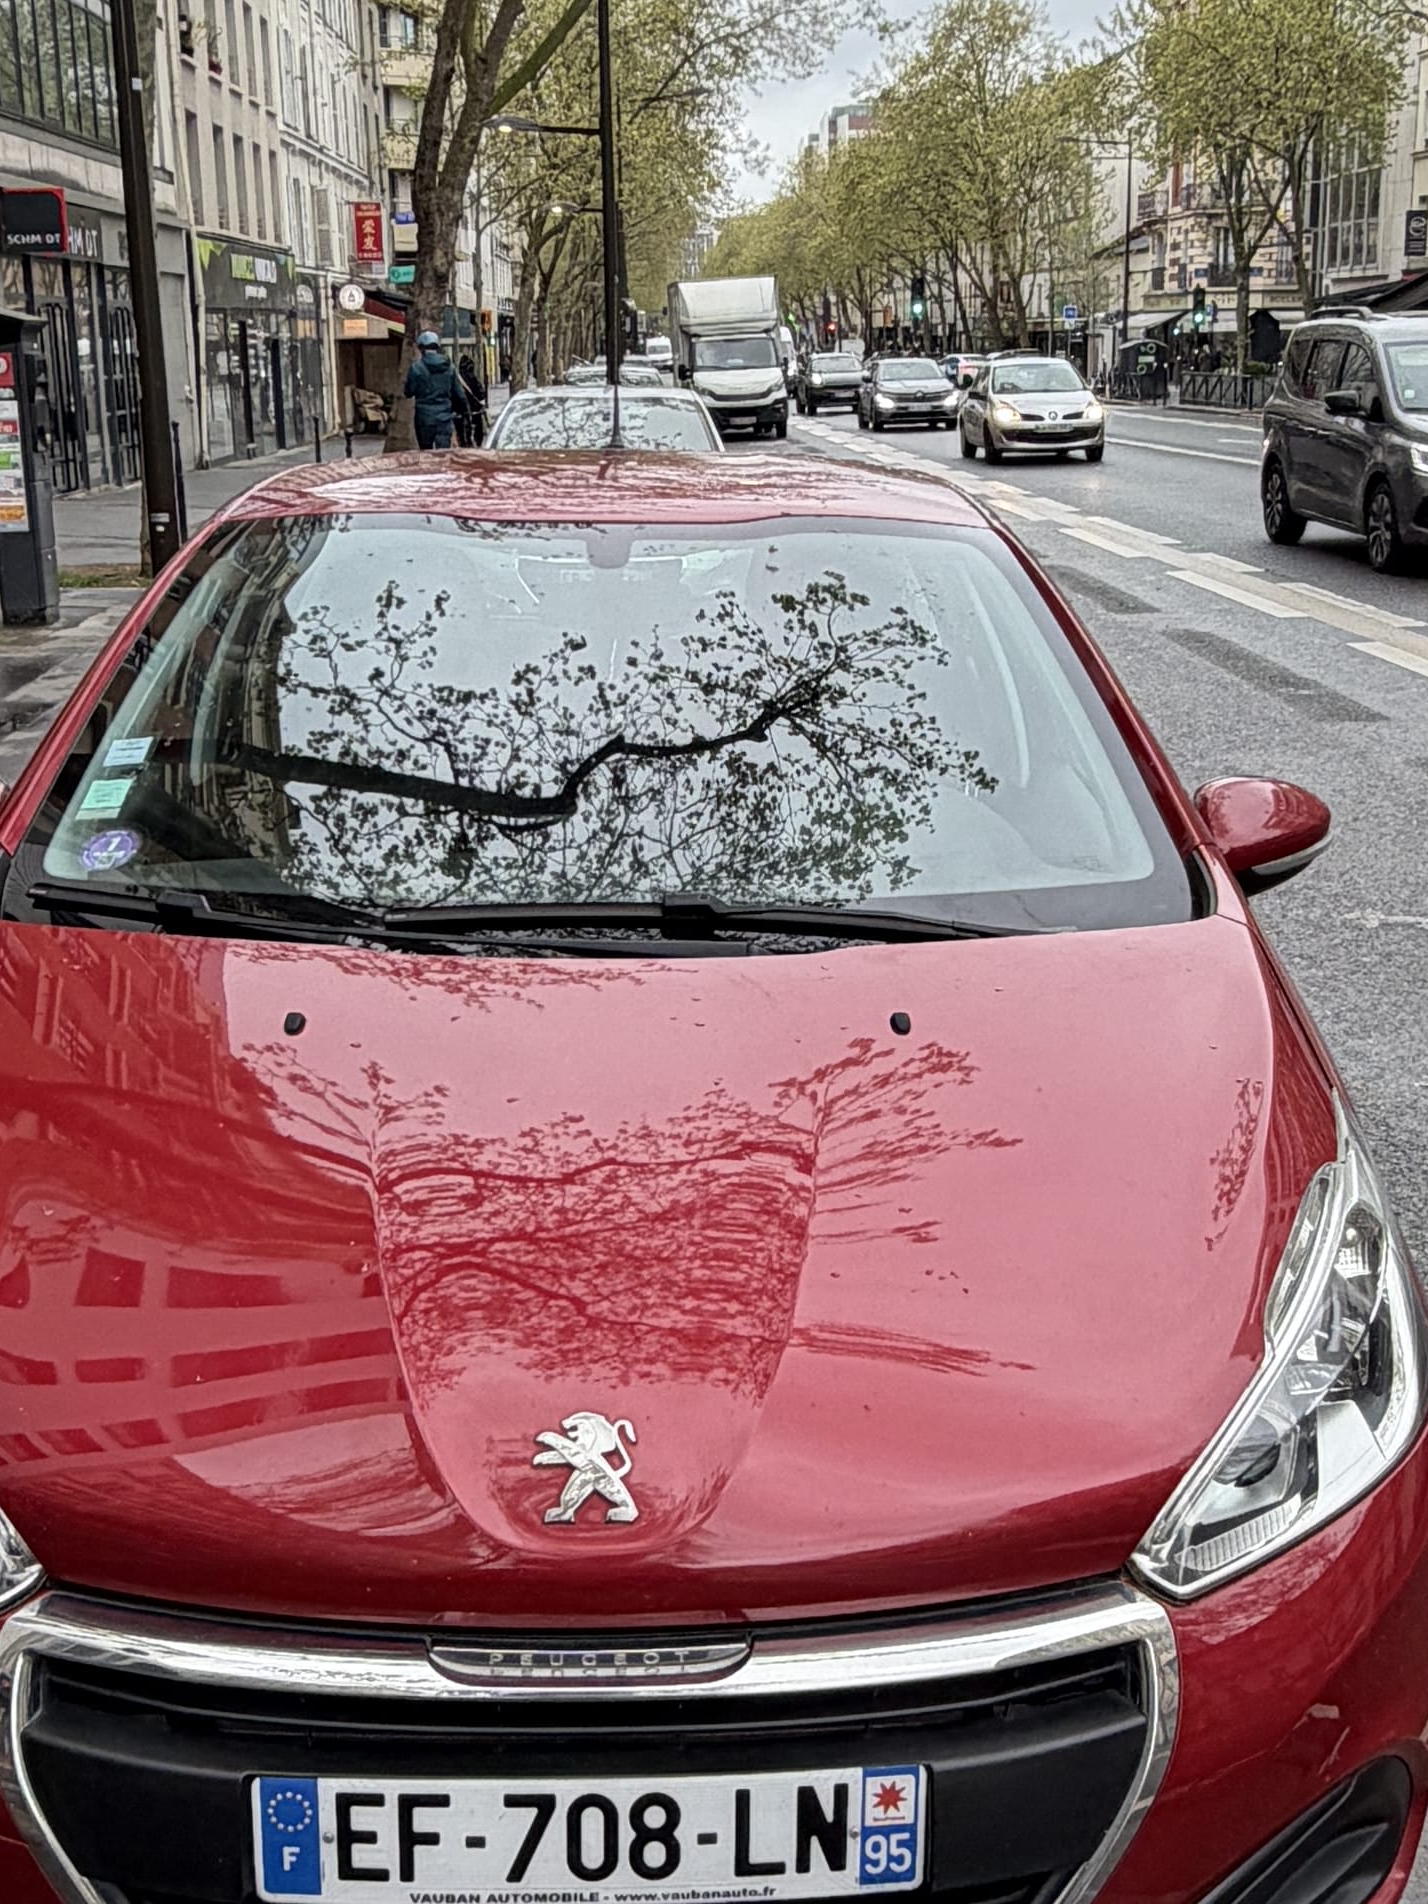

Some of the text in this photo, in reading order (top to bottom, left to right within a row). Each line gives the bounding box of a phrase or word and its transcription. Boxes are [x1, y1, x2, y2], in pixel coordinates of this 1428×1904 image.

[489, 1650, 690, 1666] PEUGEOT
[334, 1783, 849, 1883] EF-708-LN
[282, 1846, 301, 1872] F
[864, 1832, 912, 1875] 95
[409, 1892, 481, 1904] VAUBAN
[486, 1891, 599, 1904] AUTOMOBILE
[614, 1886, 777, 1903] www.vaubanauto.fr
